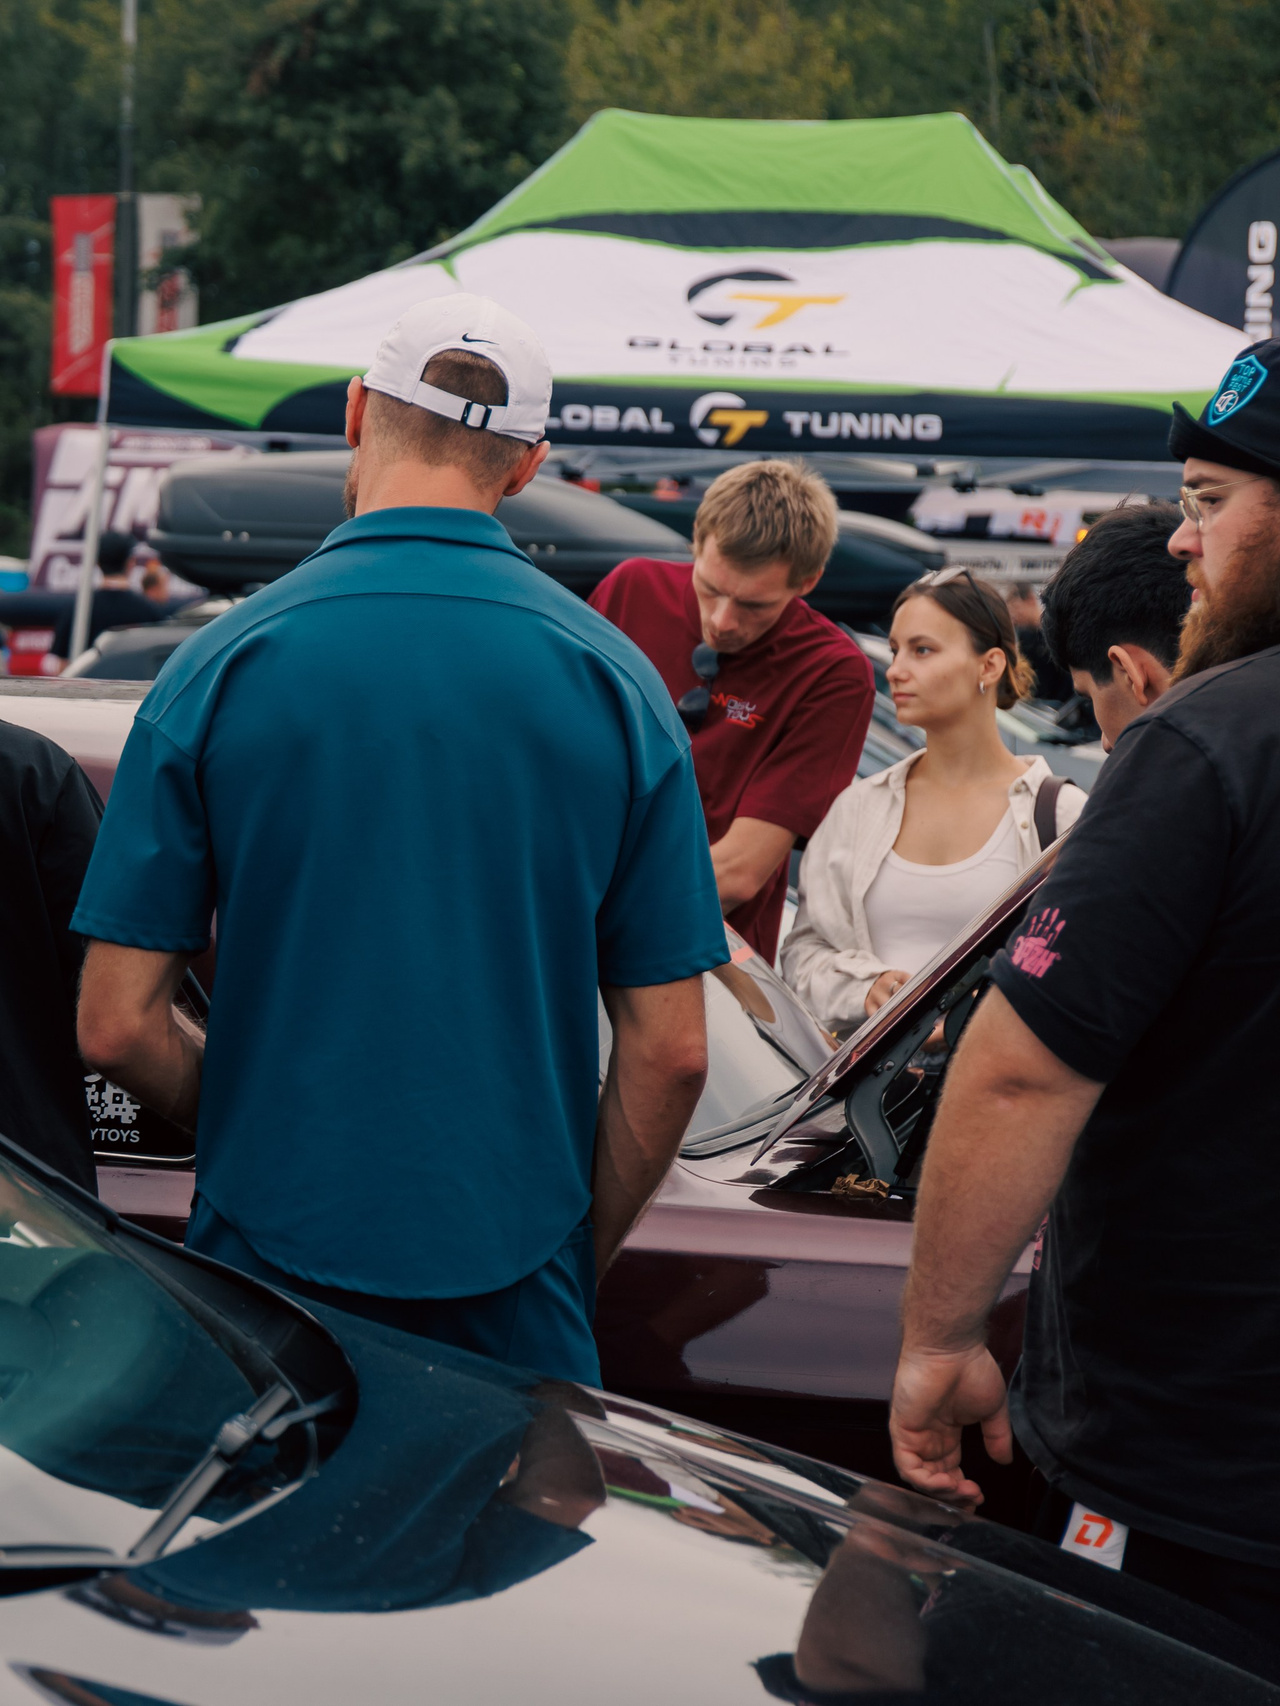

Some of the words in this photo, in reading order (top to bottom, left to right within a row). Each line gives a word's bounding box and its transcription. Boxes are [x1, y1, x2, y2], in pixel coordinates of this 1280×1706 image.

[628, 336, 849, 357] GLOBAL
[1239, 364, 1257, 376] TOP
[1228, 381, 1248, 393] FEST
[782, 411, 943, 441] TUNING
[90, 1127, 140, 1143] YTOYS
